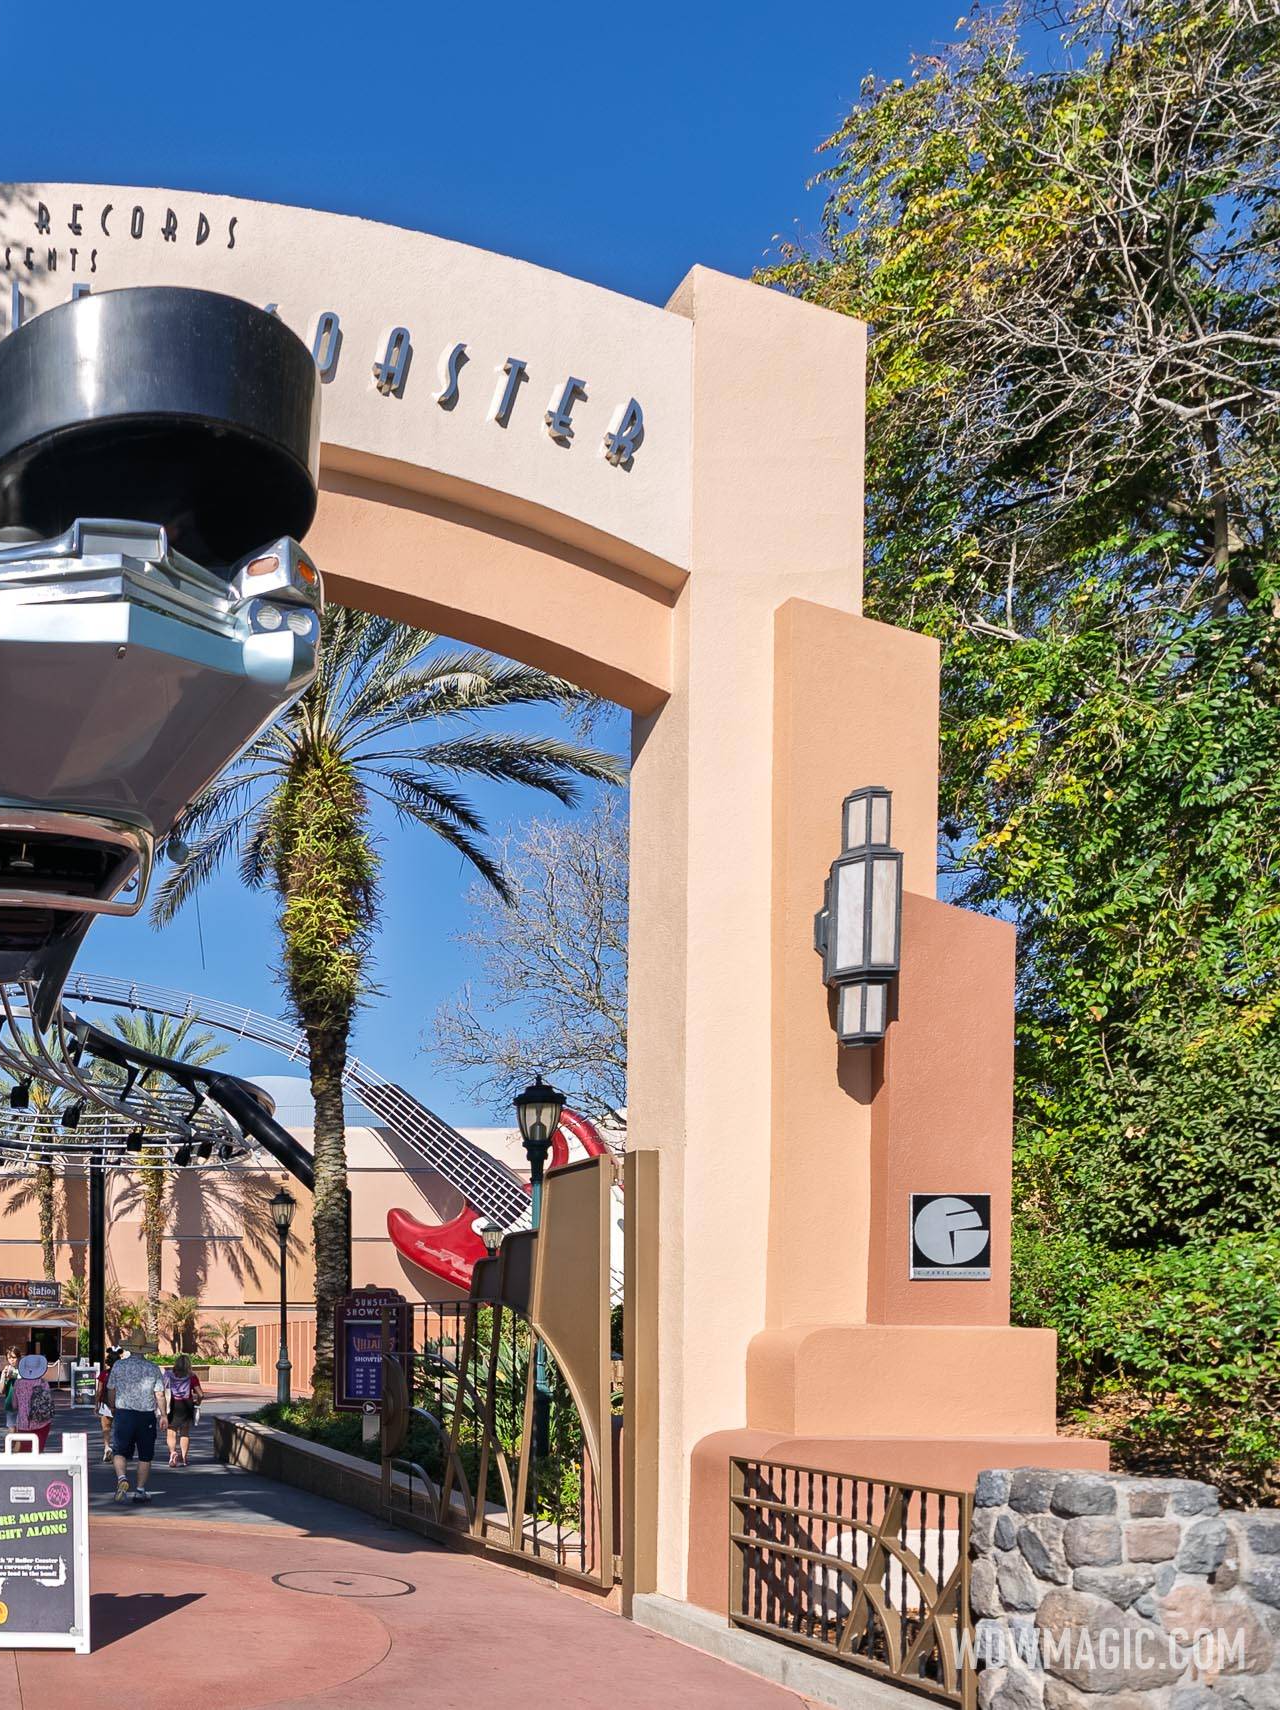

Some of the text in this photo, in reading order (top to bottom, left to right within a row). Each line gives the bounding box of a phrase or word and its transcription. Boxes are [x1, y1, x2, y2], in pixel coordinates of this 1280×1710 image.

[35, 201, 239, 249] RECORDS
[262, 303, 646, 468] OASTER
[28, 1285, 56, 1297] Station
[346, 1308, 397, 1316] SHOWCE
[19, 1509, 67, 1524] MOVING
[26, 1523, 67, 1537] ALONG
